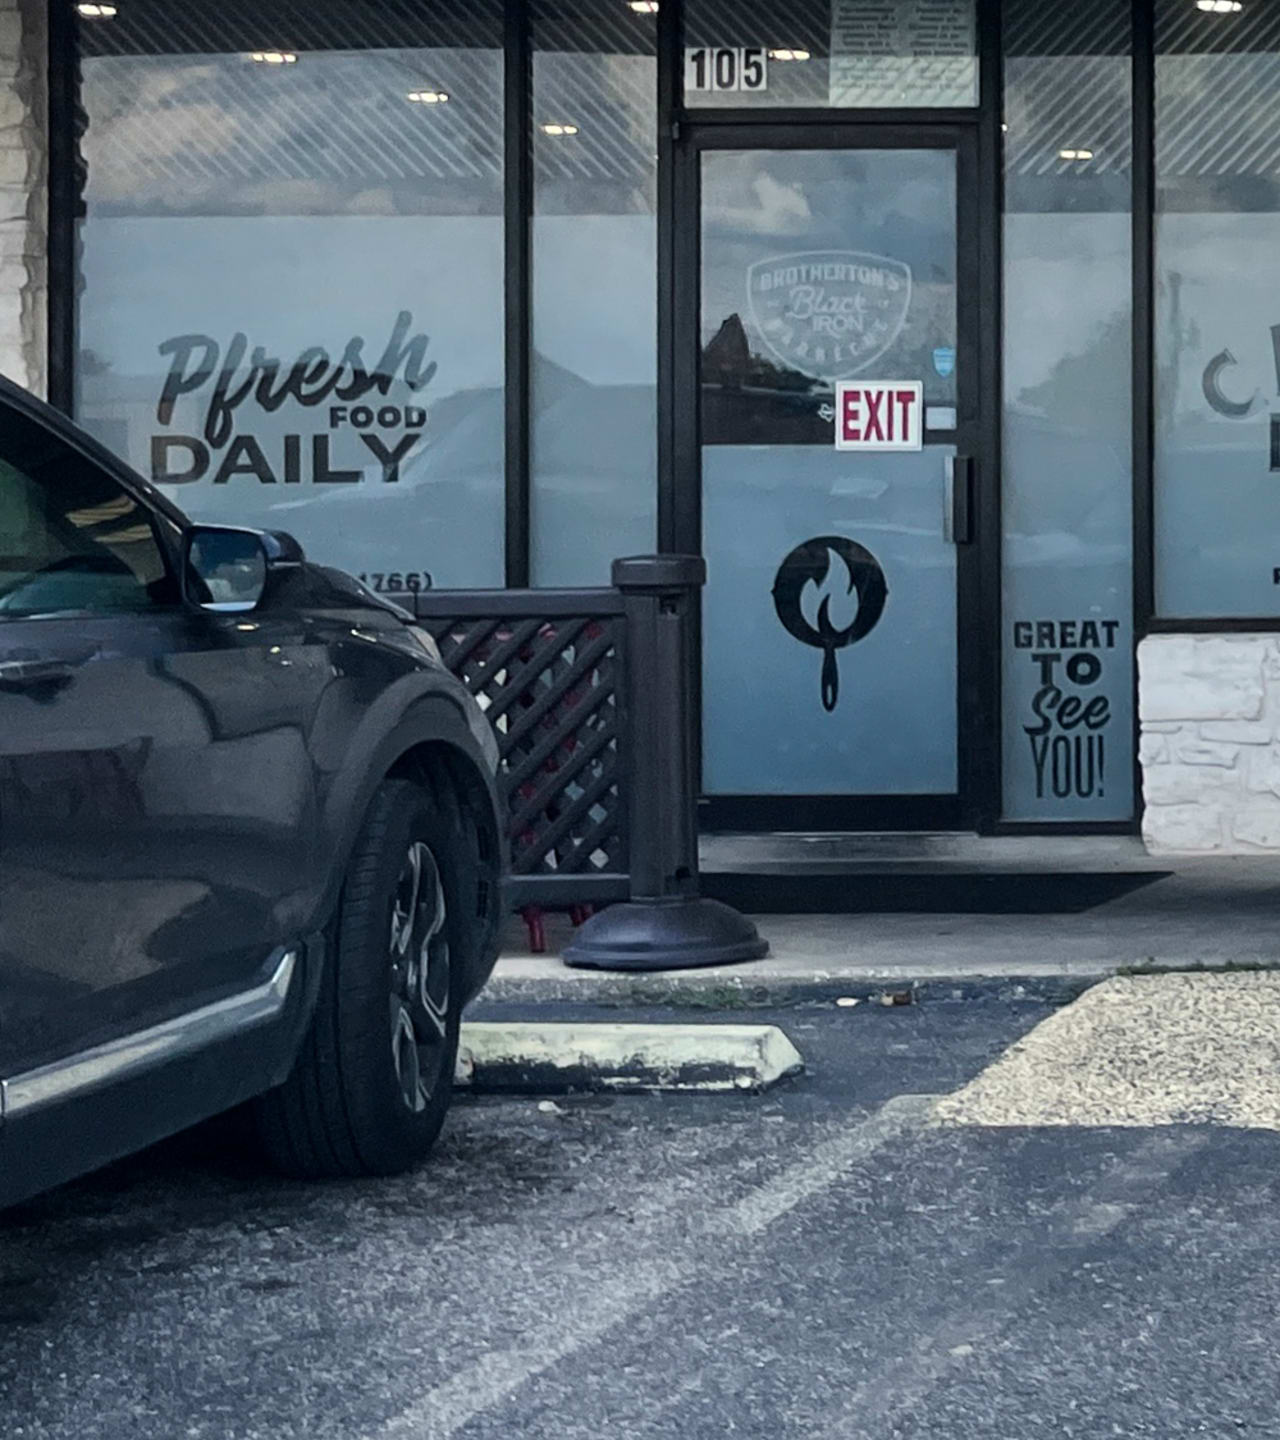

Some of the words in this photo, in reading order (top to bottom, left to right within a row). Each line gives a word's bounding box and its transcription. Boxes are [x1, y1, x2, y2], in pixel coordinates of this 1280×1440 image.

[691, 49, 763, 89] 105
[812, 316, 865, 339] IRON
[157, 310, 438, 449] Pfresh
[330, 406, 427, 429] FOOD
[843, 390, 915, 441] EXIT
[151, 434, 421, 484] DAILY
[1014, 621, 1119, 648] GREAT
[1031, 652, 1101, 685] TO
[1023, 684, 1111, 736] See
[1030, 735, 1104, 798] YOU!
